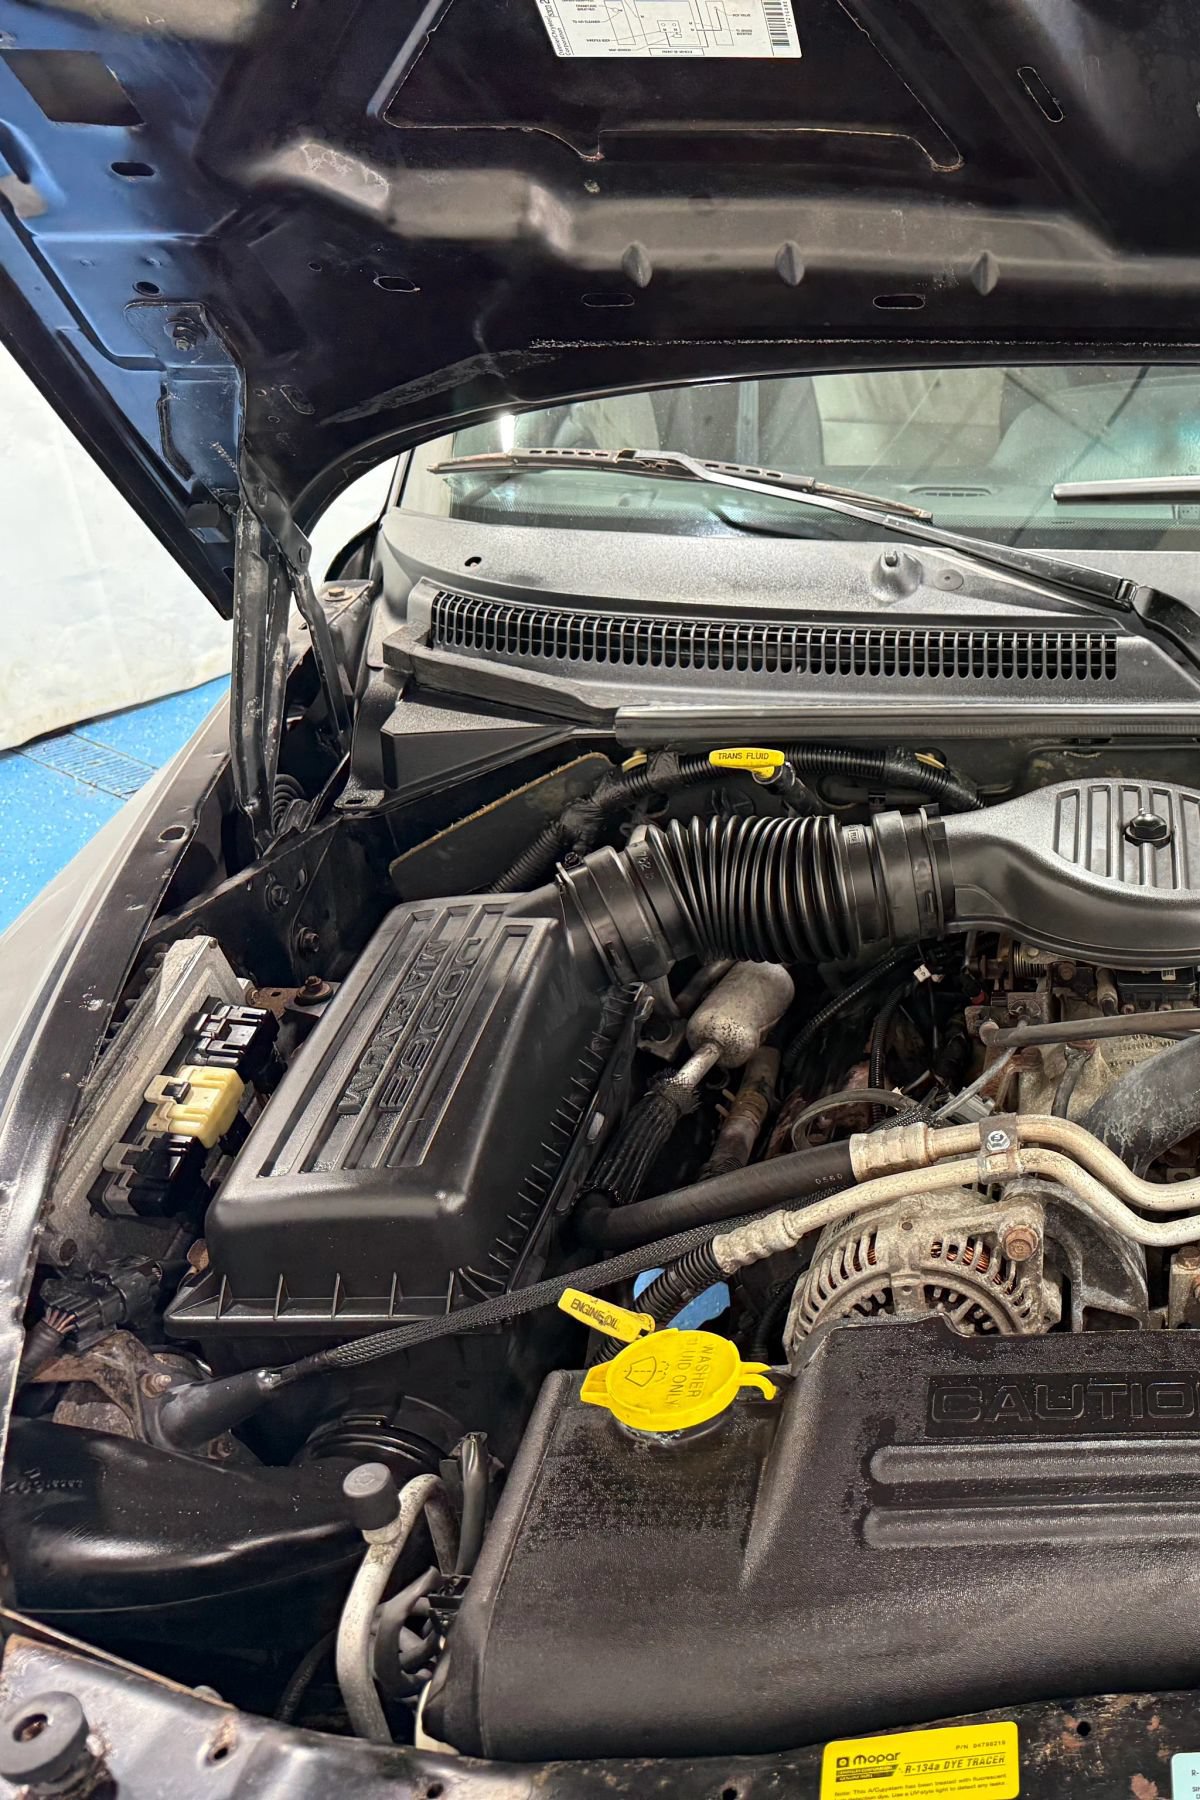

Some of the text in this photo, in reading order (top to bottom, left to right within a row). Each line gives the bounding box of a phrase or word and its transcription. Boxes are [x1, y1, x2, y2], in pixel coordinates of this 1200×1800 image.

[718, 752, 769, 760] TRANS FLUID
[379, 937, 488, 1112] DODGE
[570, 1297, 620, 1331] ENGINE OIL
[686, 1343, 713, 1399] WASHER
[664, 1373, 686, 1409] ONLY
[904, 1755, 1006, 1774] R-134a DYE TRACER
